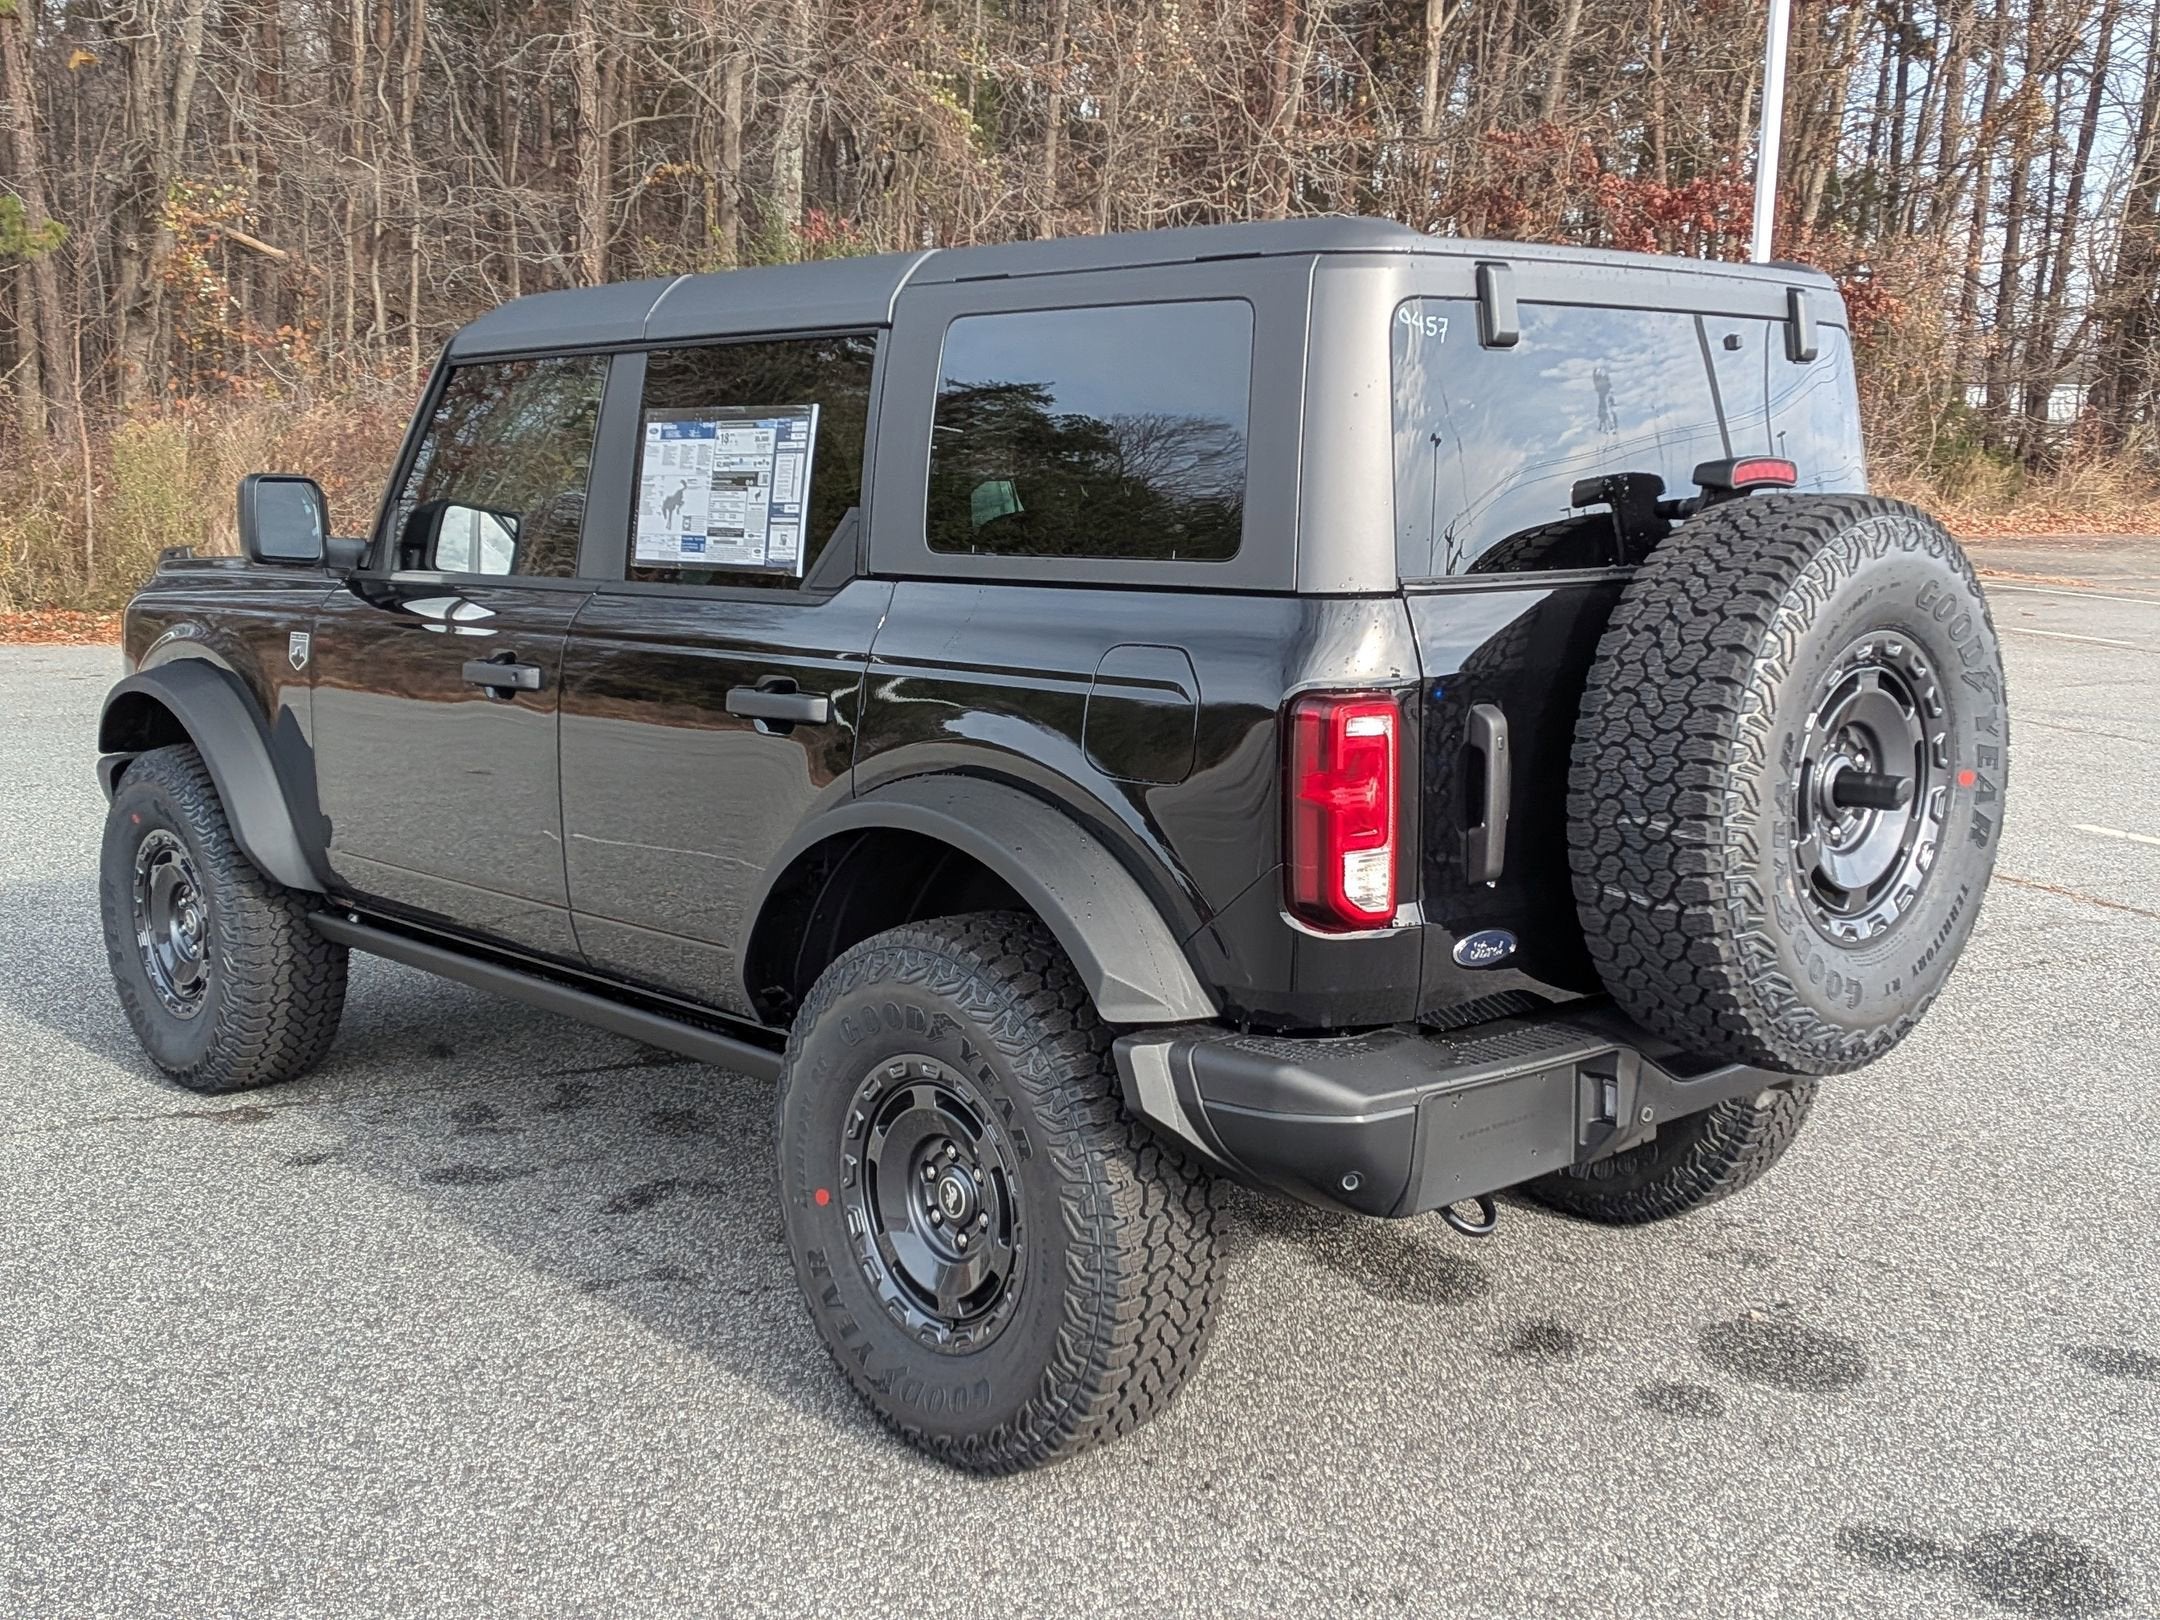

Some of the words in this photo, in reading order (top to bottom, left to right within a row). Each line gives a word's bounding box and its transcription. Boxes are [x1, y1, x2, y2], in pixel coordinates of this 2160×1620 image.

[1398, 307, 1449, 343] 0457
[1915, 578, 2000, 850] GOODYEAR
[1911, 884, 1970, 977] TERRITORY
[838, 1000, 1034, 1162] GOODYEAR
[808, 1247, 992, 1411] GOODYEAR
